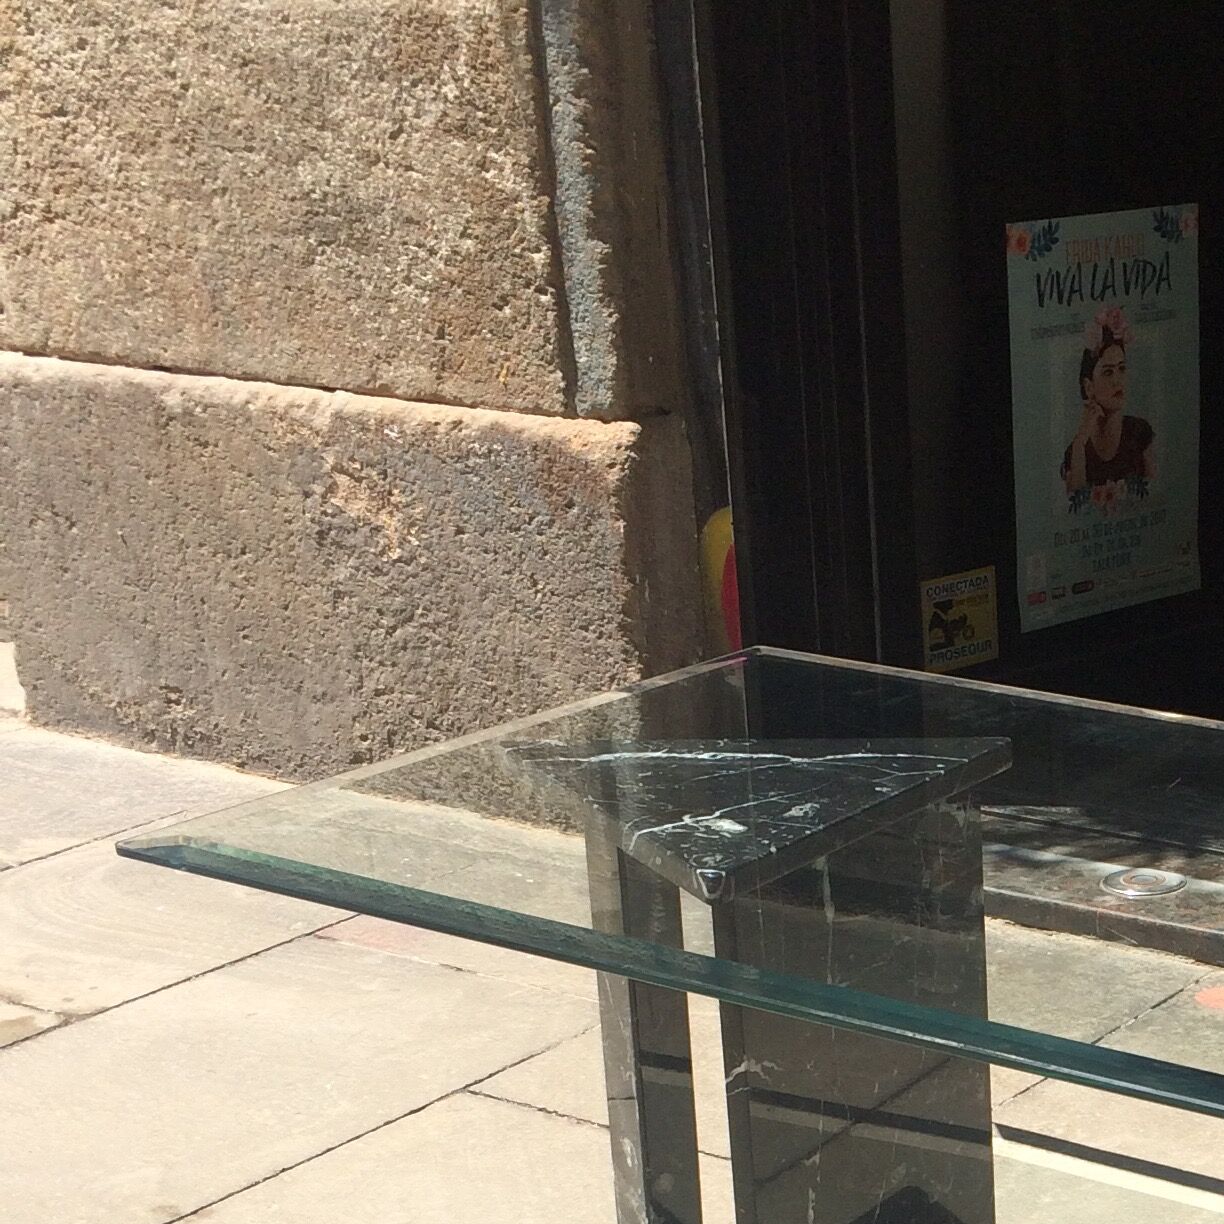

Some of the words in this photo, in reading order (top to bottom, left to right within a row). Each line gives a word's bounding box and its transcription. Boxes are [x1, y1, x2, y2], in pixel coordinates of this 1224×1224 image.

[1036, 262, 1084, 308] VIVA
[1090, 257, 1118, 302] LA
[1122, 250, 1173, 299] VIDA
[926, 575, 990, 598] CONECTADA
[929, 639, 993, 664] PROSEGUR
